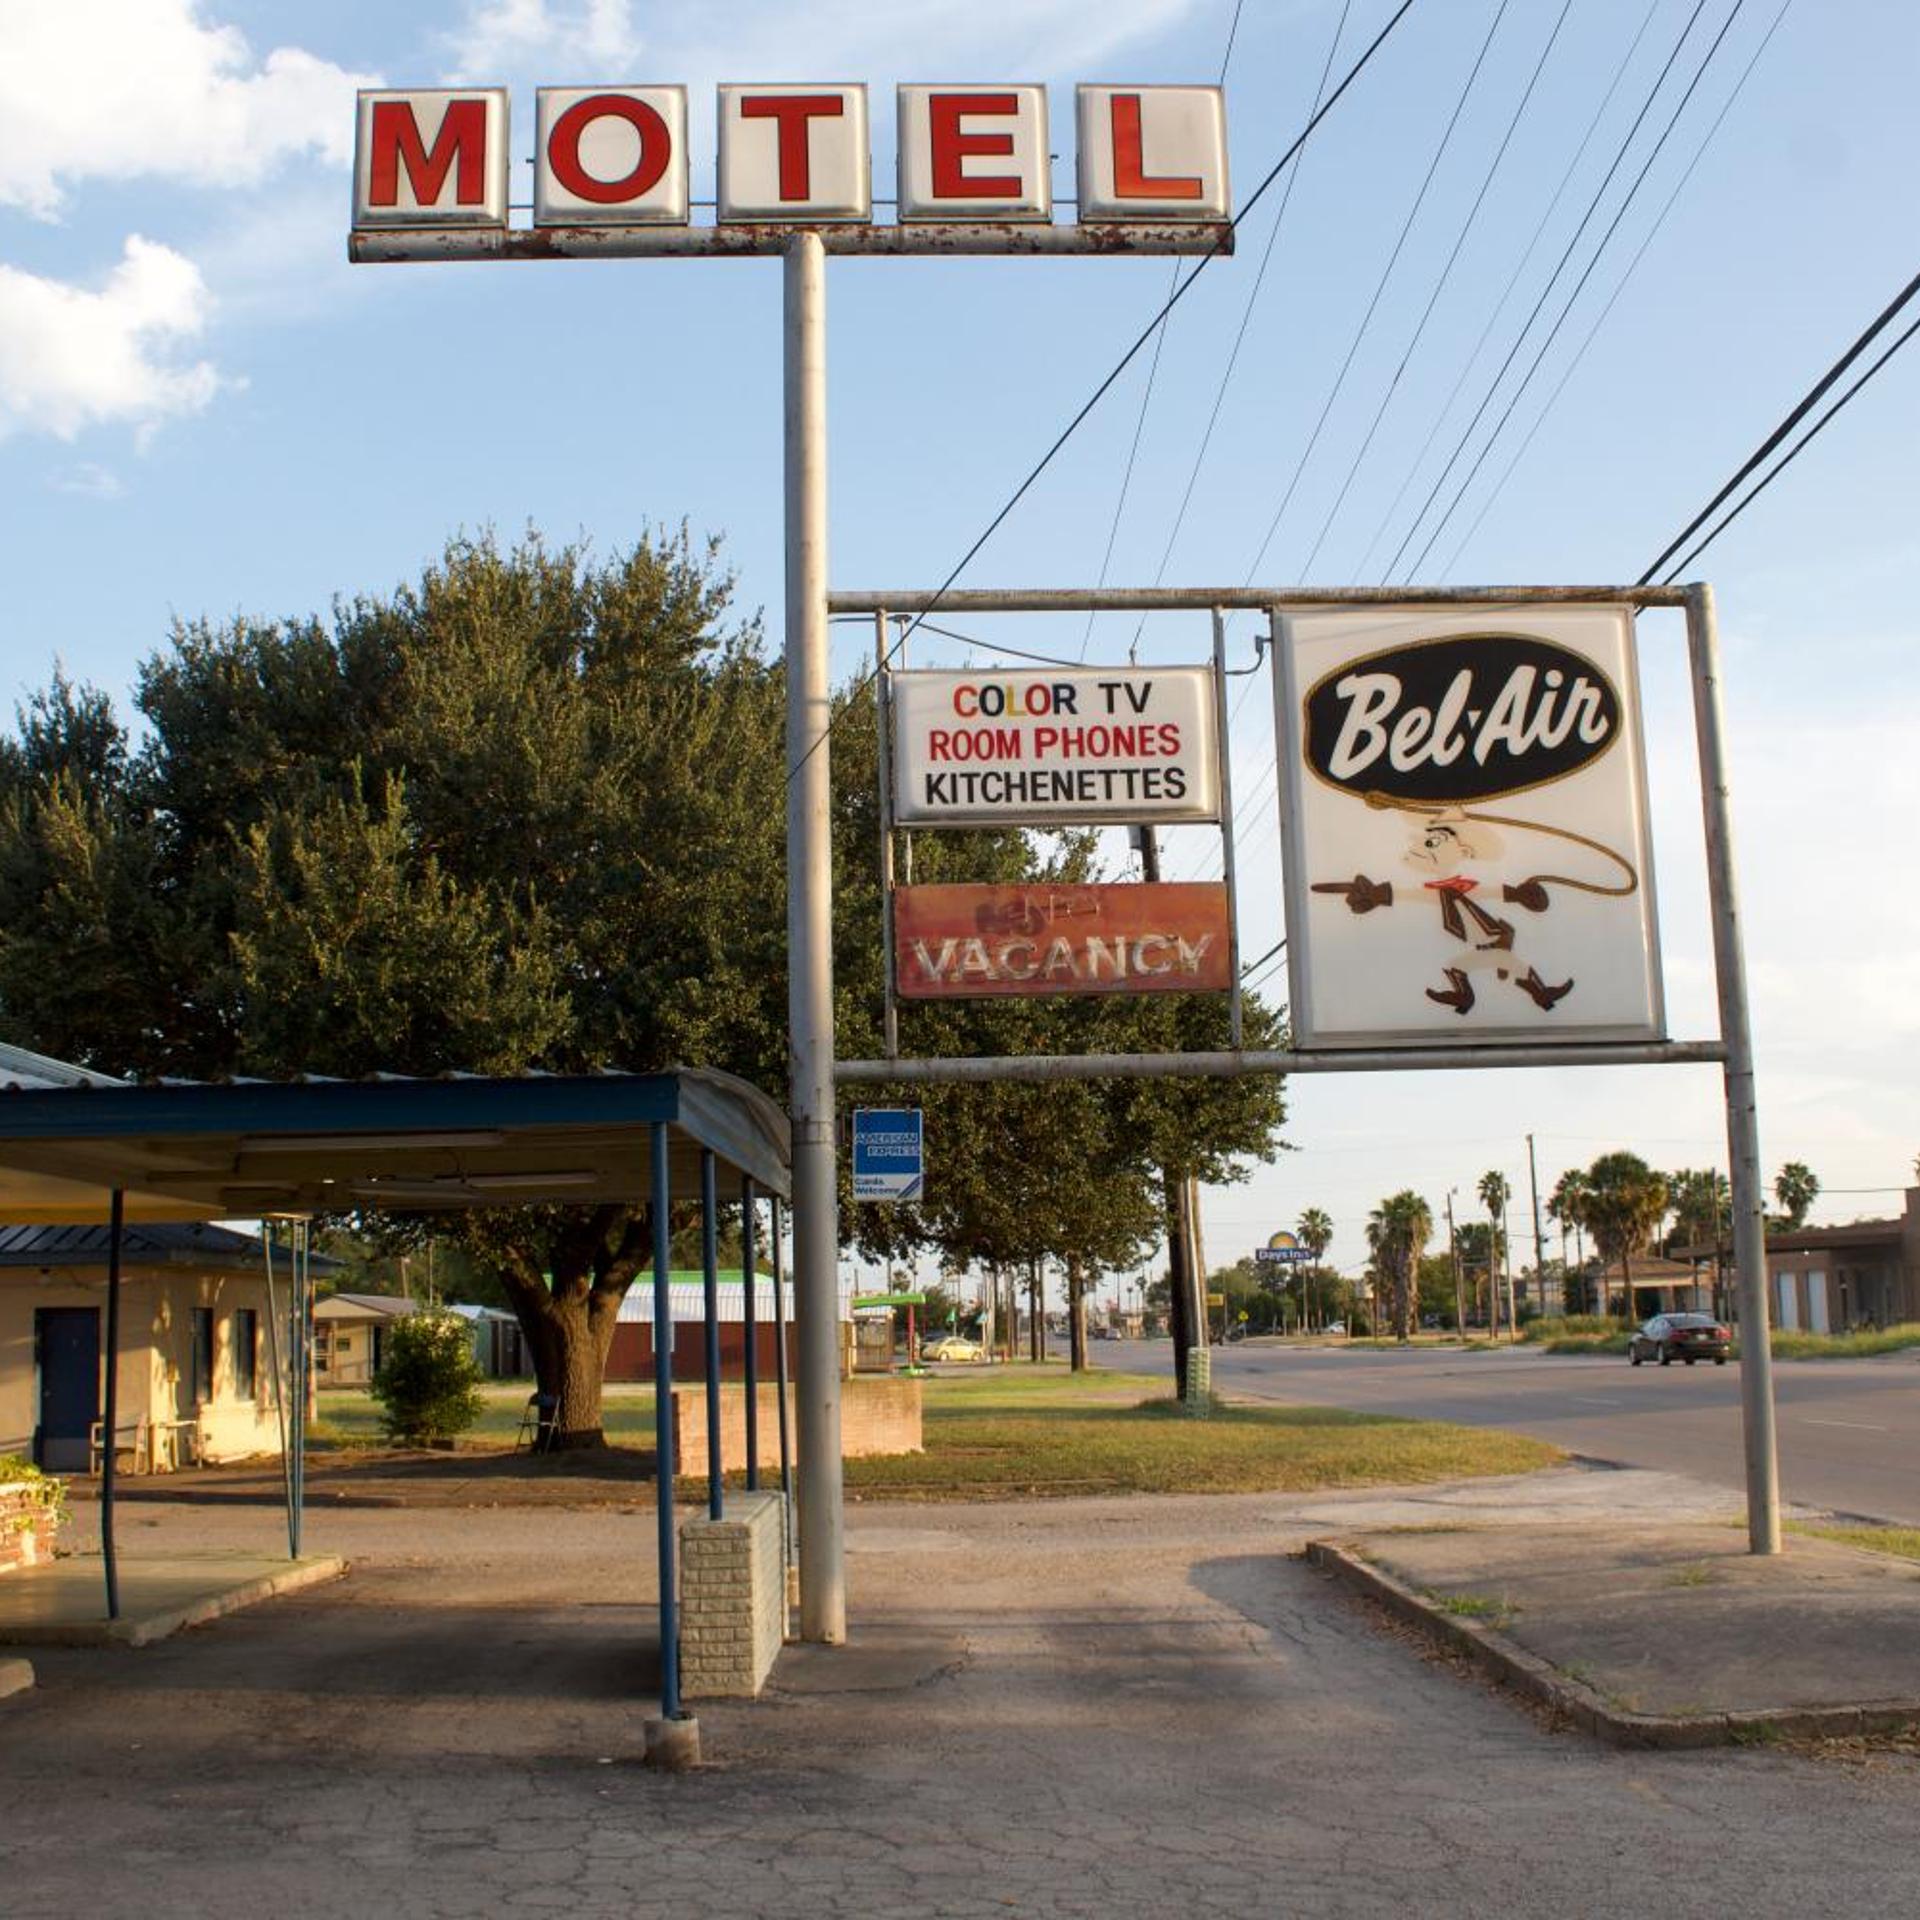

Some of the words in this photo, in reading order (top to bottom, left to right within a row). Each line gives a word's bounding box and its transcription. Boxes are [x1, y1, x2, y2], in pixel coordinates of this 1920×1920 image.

[368, 93, 1203, 206] MOTEL
[953, 683, 1078, 719] COLOR
[1098, 682, 1152, 714] TV
[1328, 664, 1609, 780] Bel-Air
[929, 728, 1021, 762] ROOM
[1034, 723, 1181, 759] PHONES
[925, 767, 1187, 805] KITCHENETTES
[908, 932, 1215, 982] VACANCY
